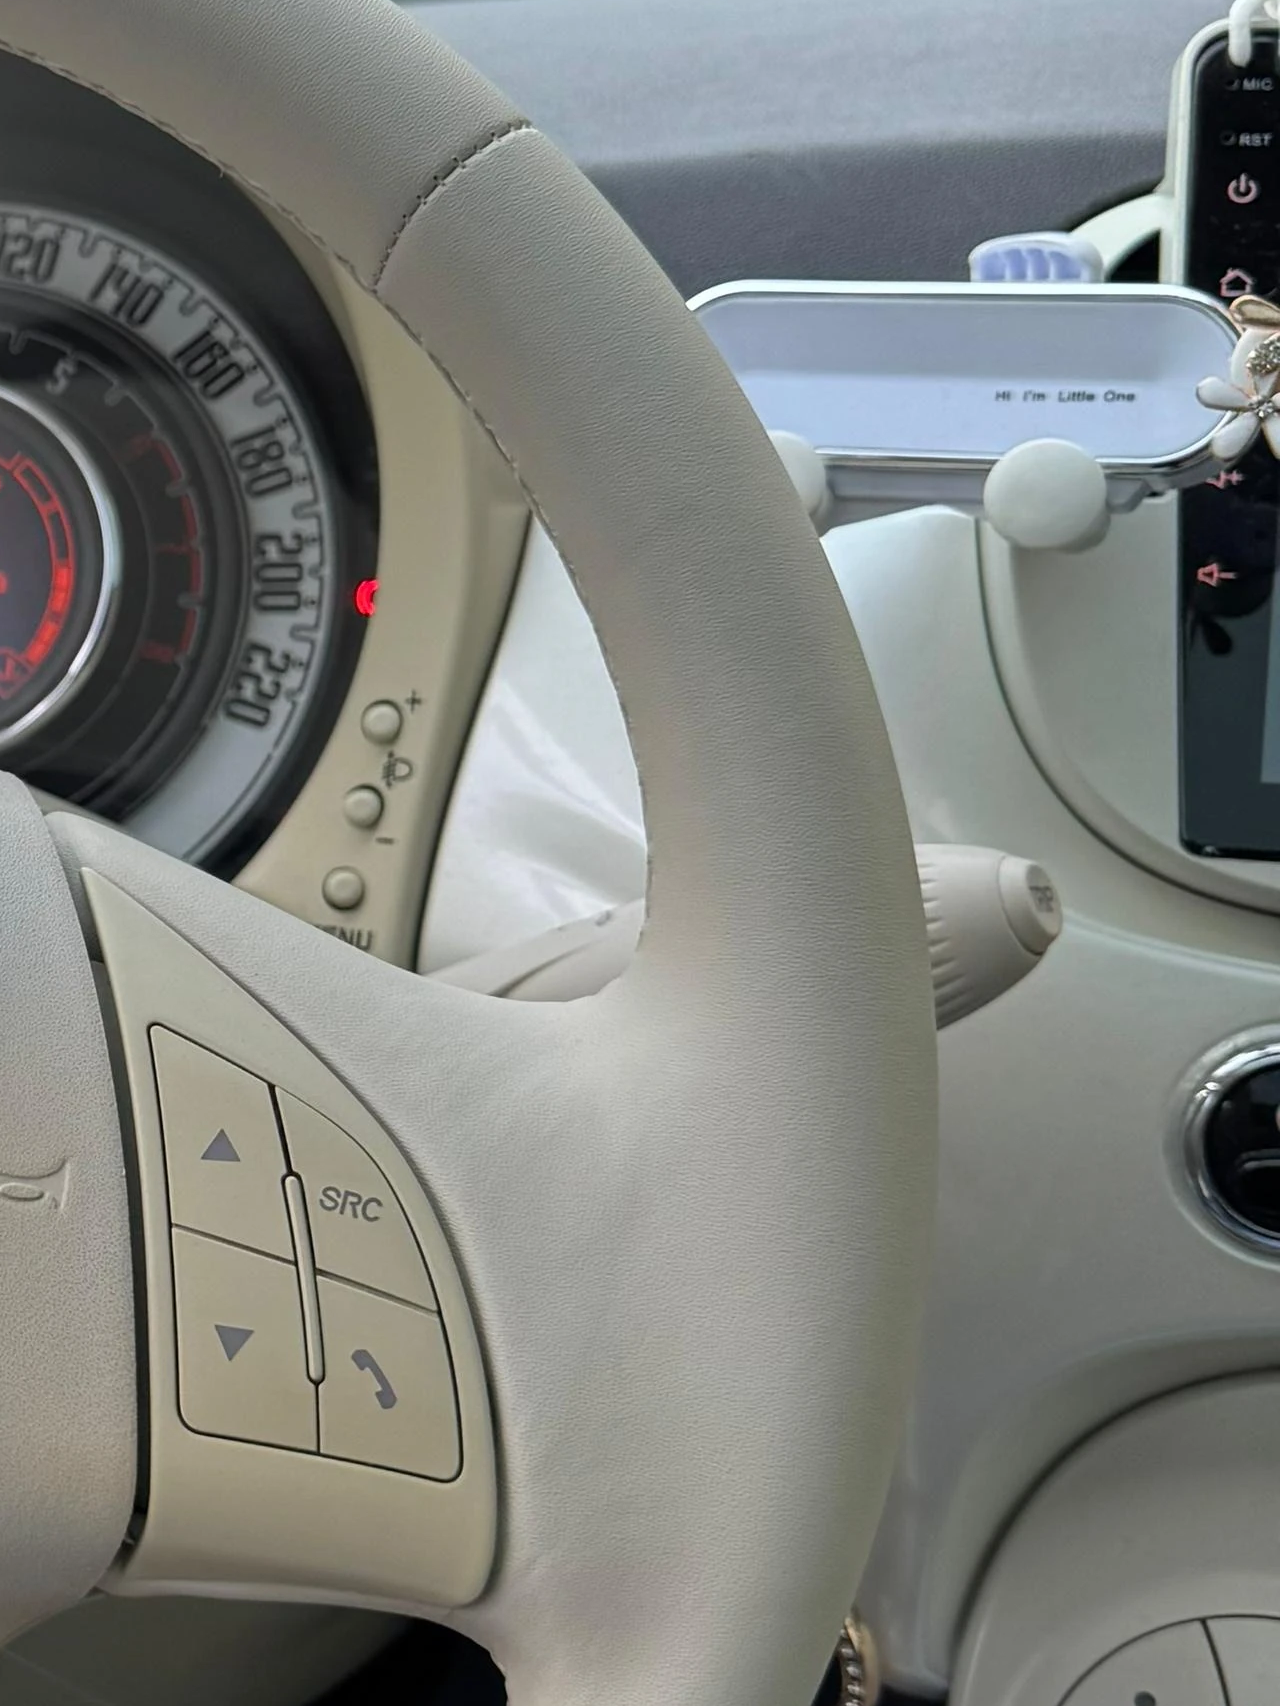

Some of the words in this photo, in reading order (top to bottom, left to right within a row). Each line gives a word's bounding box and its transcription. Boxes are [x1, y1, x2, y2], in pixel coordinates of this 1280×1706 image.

[1243, 77, 1274, 91] MIC
[1239, 132, 1273, 147] RST
[86, 259, 166, 328] 140
[170, 328, 246, 400] 160
[1057, 389, 1096, 403] Little
[1104, 389, 1136, 403] One
[231, 426, 293, 498] 180
[253, 533, 304, 612] 200
[225, 643, 292, 729] 220
[319, 1186, 383, 1222] SRC
